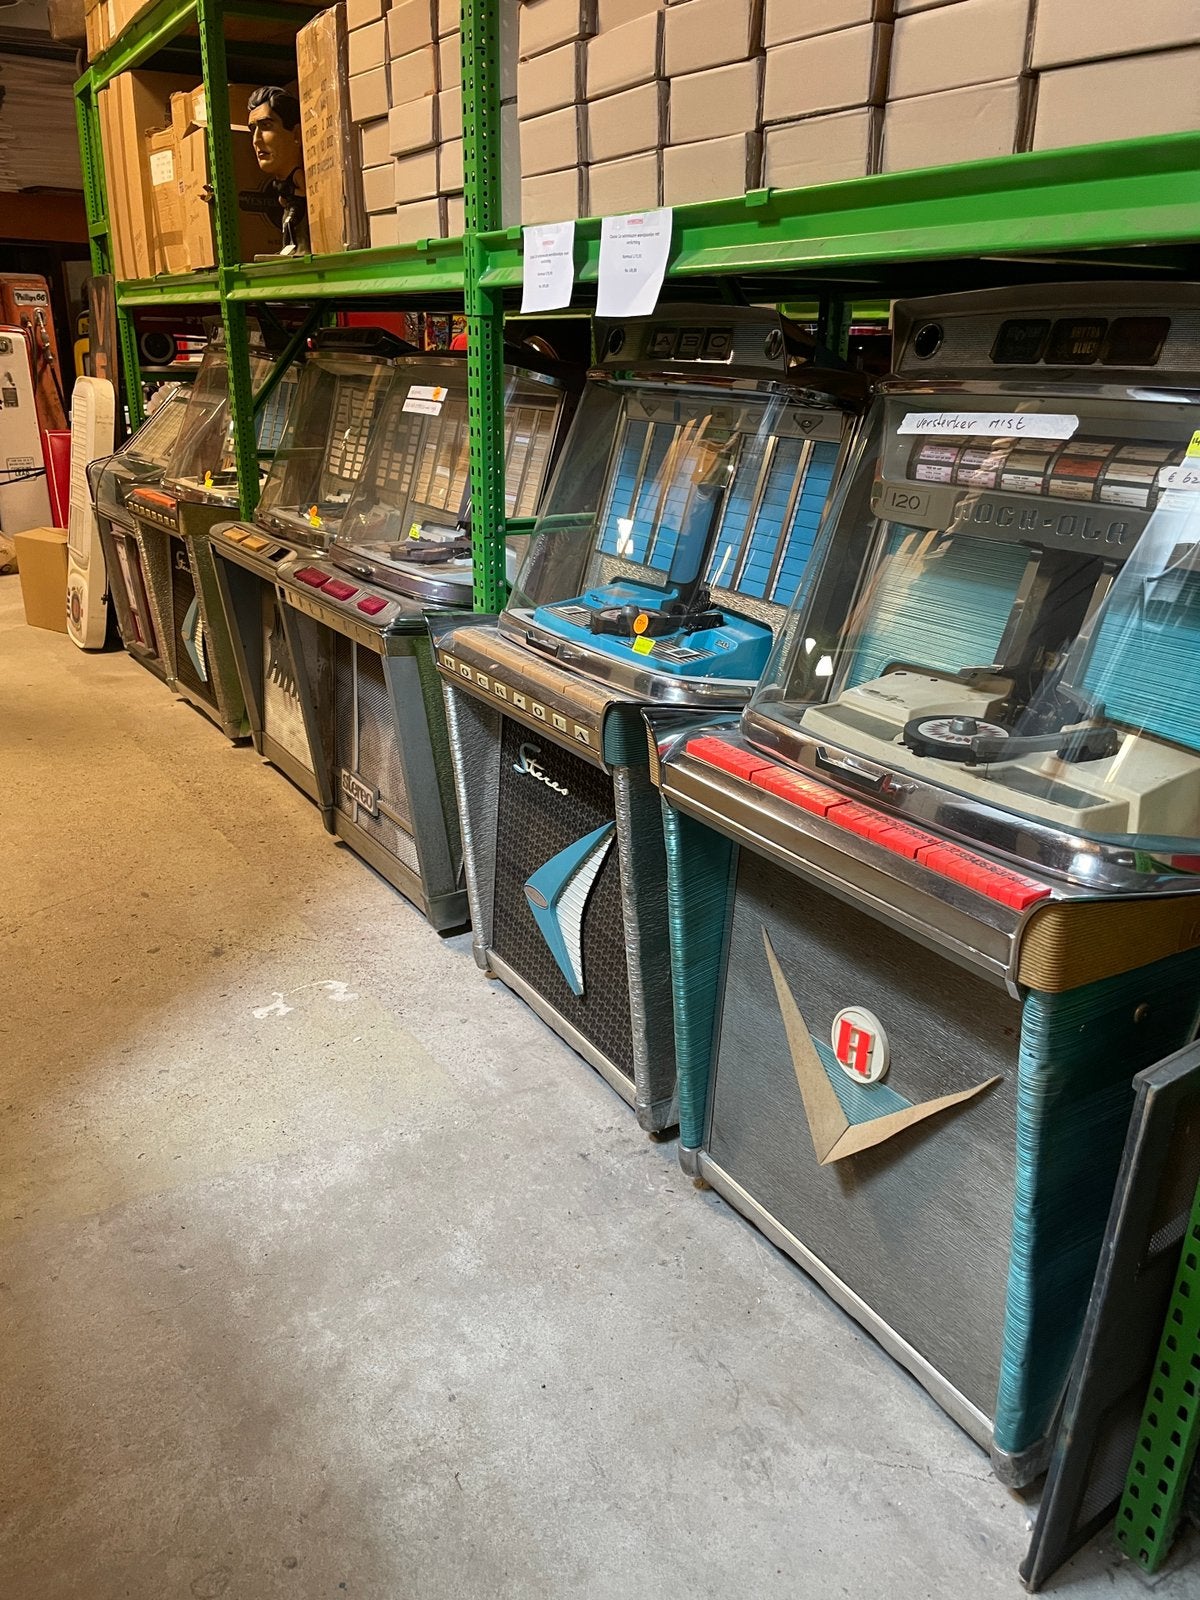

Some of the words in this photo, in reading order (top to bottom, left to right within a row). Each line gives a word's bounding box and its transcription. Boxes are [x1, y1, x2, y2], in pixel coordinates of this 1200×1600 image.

[36, 293, 46, 301] 66
[916, 414, 977, 430] versterker
[891, 494, 921, 511] 120
[342, 773, 374, 810] stereo
